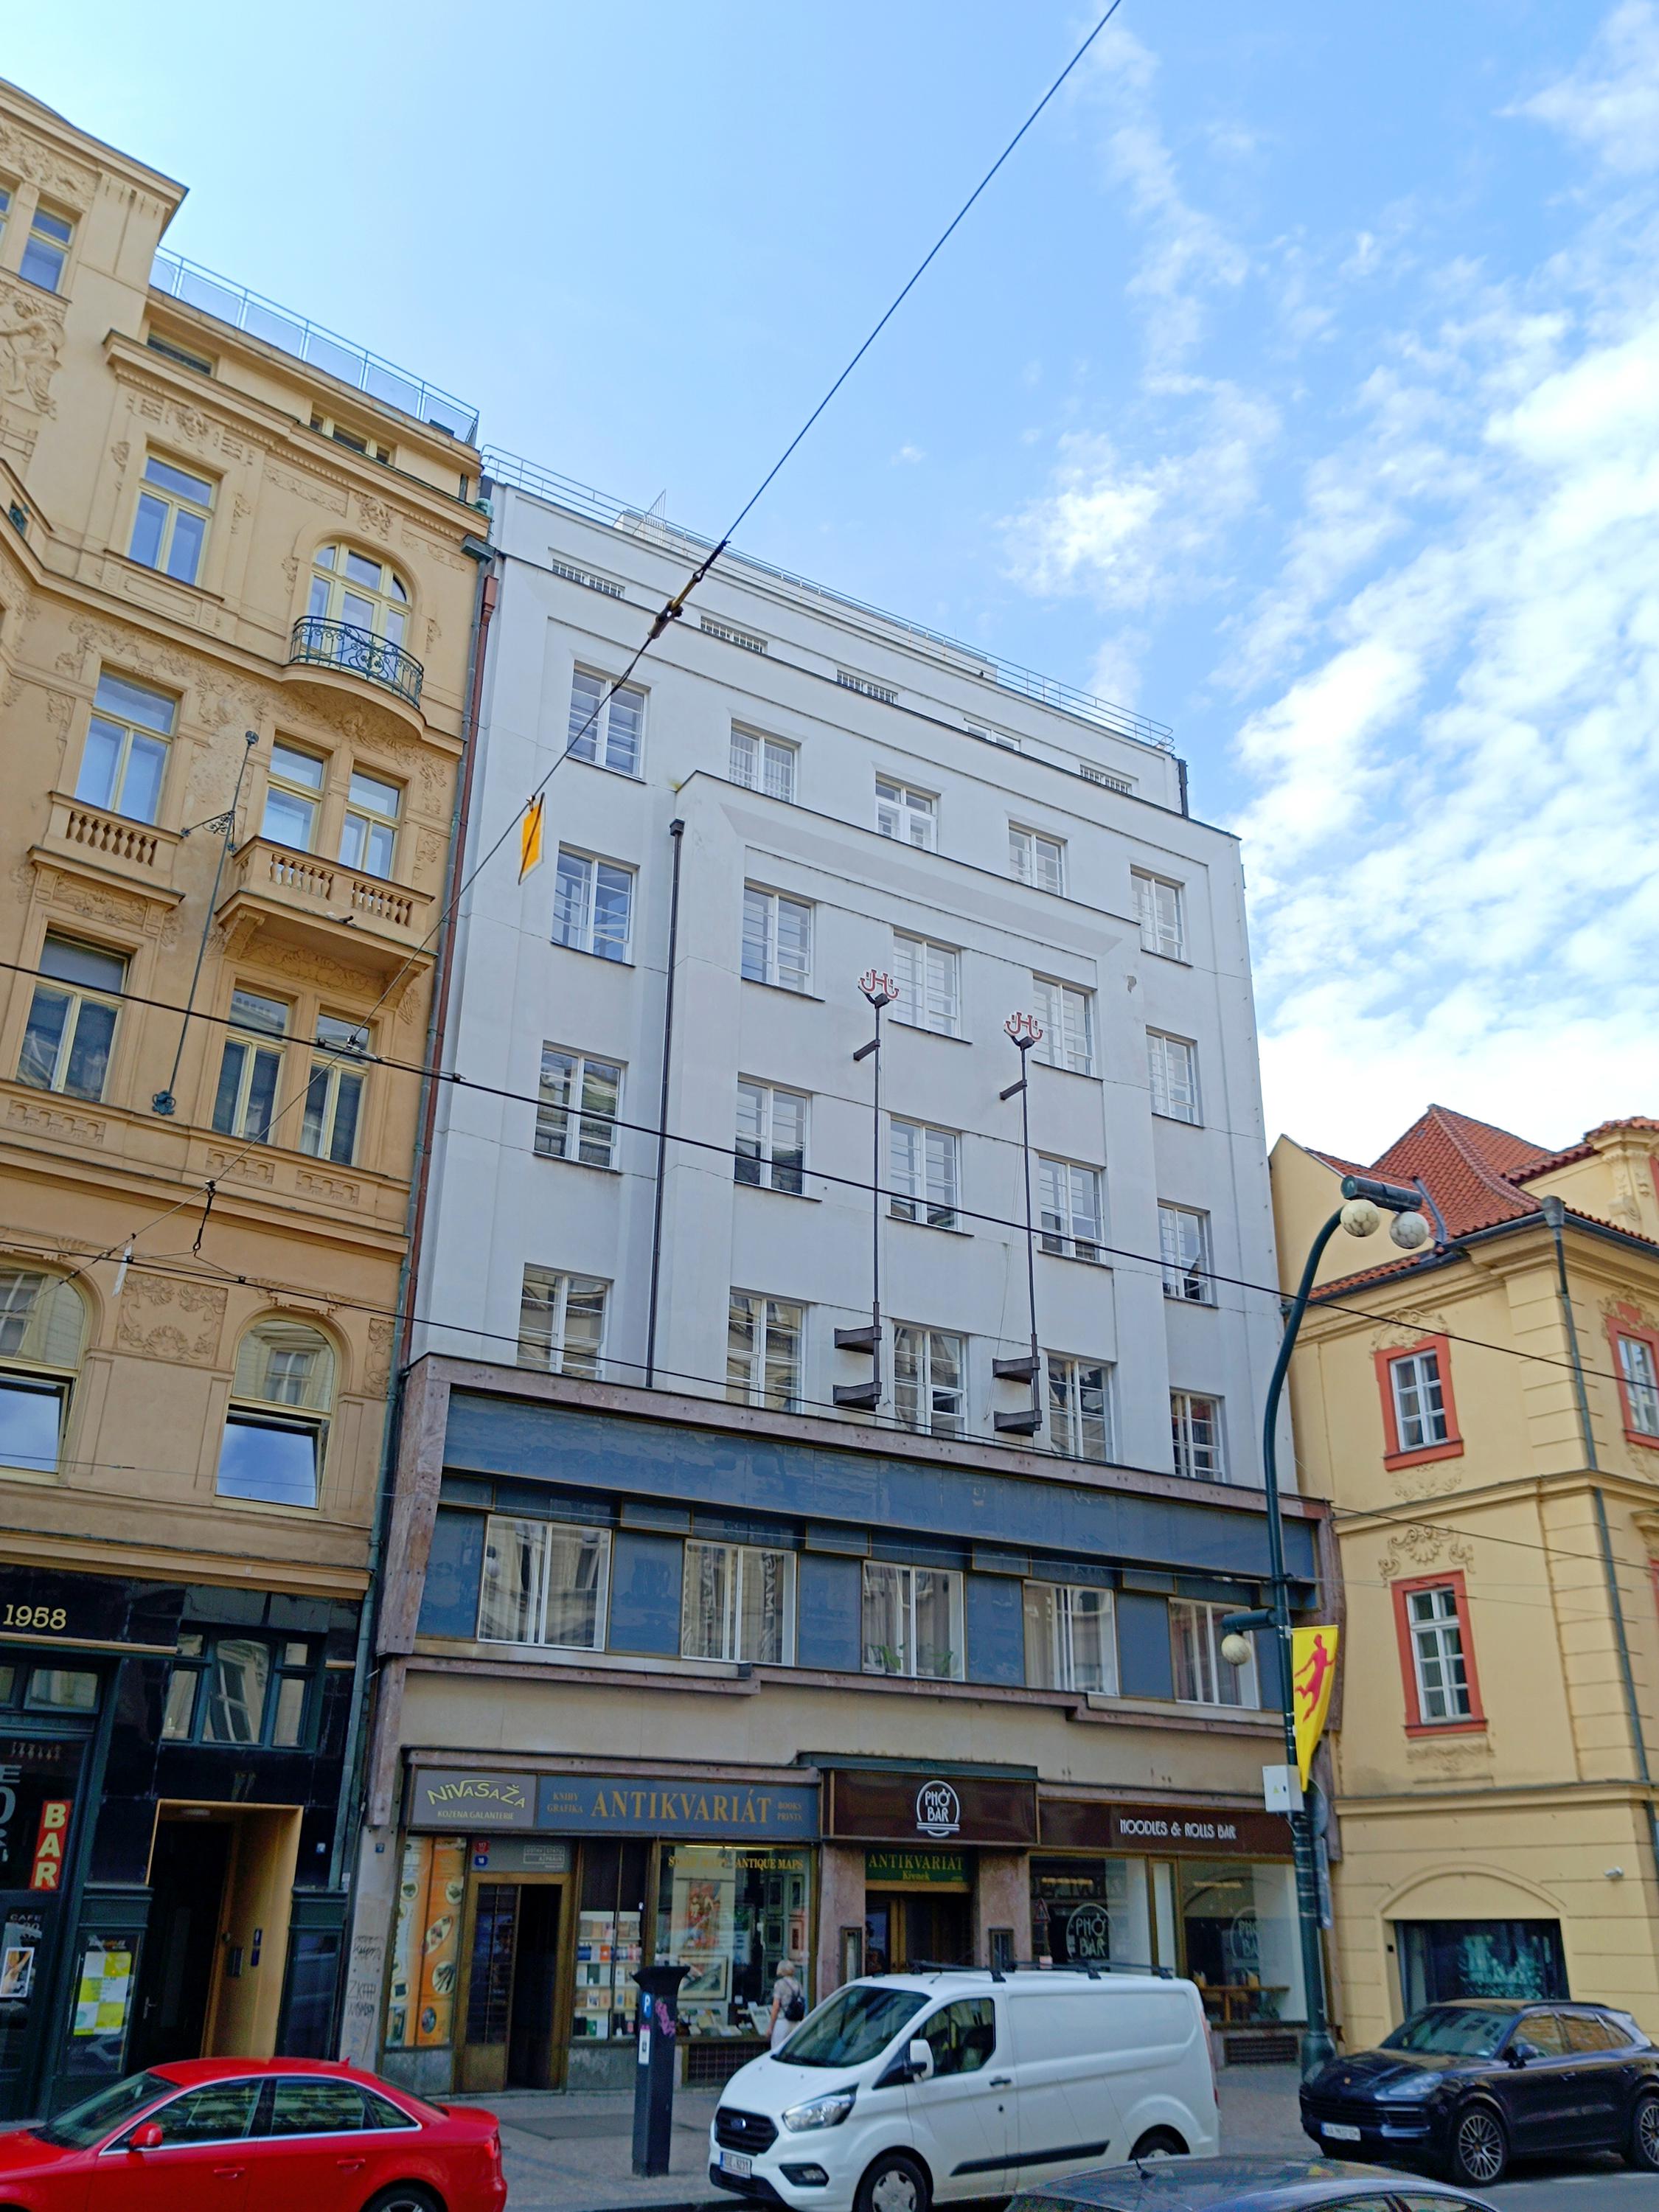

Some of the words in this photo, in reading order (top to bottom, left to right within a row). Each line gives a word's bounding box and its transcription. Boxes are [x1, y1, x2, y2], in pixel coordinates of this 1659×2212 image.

[3, 1604, 66, 1630] 1958
[553, 1792, 579, 1801] KNIHY
[547, 1804, 583, 1814] GRAFIKA
[591, 1790, 772, 1823] ANTIKVARIÁT
[927, 1806, 950, 1823] BAR
[1119, 1818, 1169, 1836] NOODLES
[1171, 1821, 1181, 1837] &
[1185, 1823, 1215, 1838] ROLLS
[1217, 1824, 1237, 1840] BAR
[34, 1804, 66, 1888] BAR
[736, 1857, 776, 1870] ANTIQUE
[779, 1859, 804, 1870] MAPS
[869, 1853, 964, 1870] ANTIKVARIÁT
